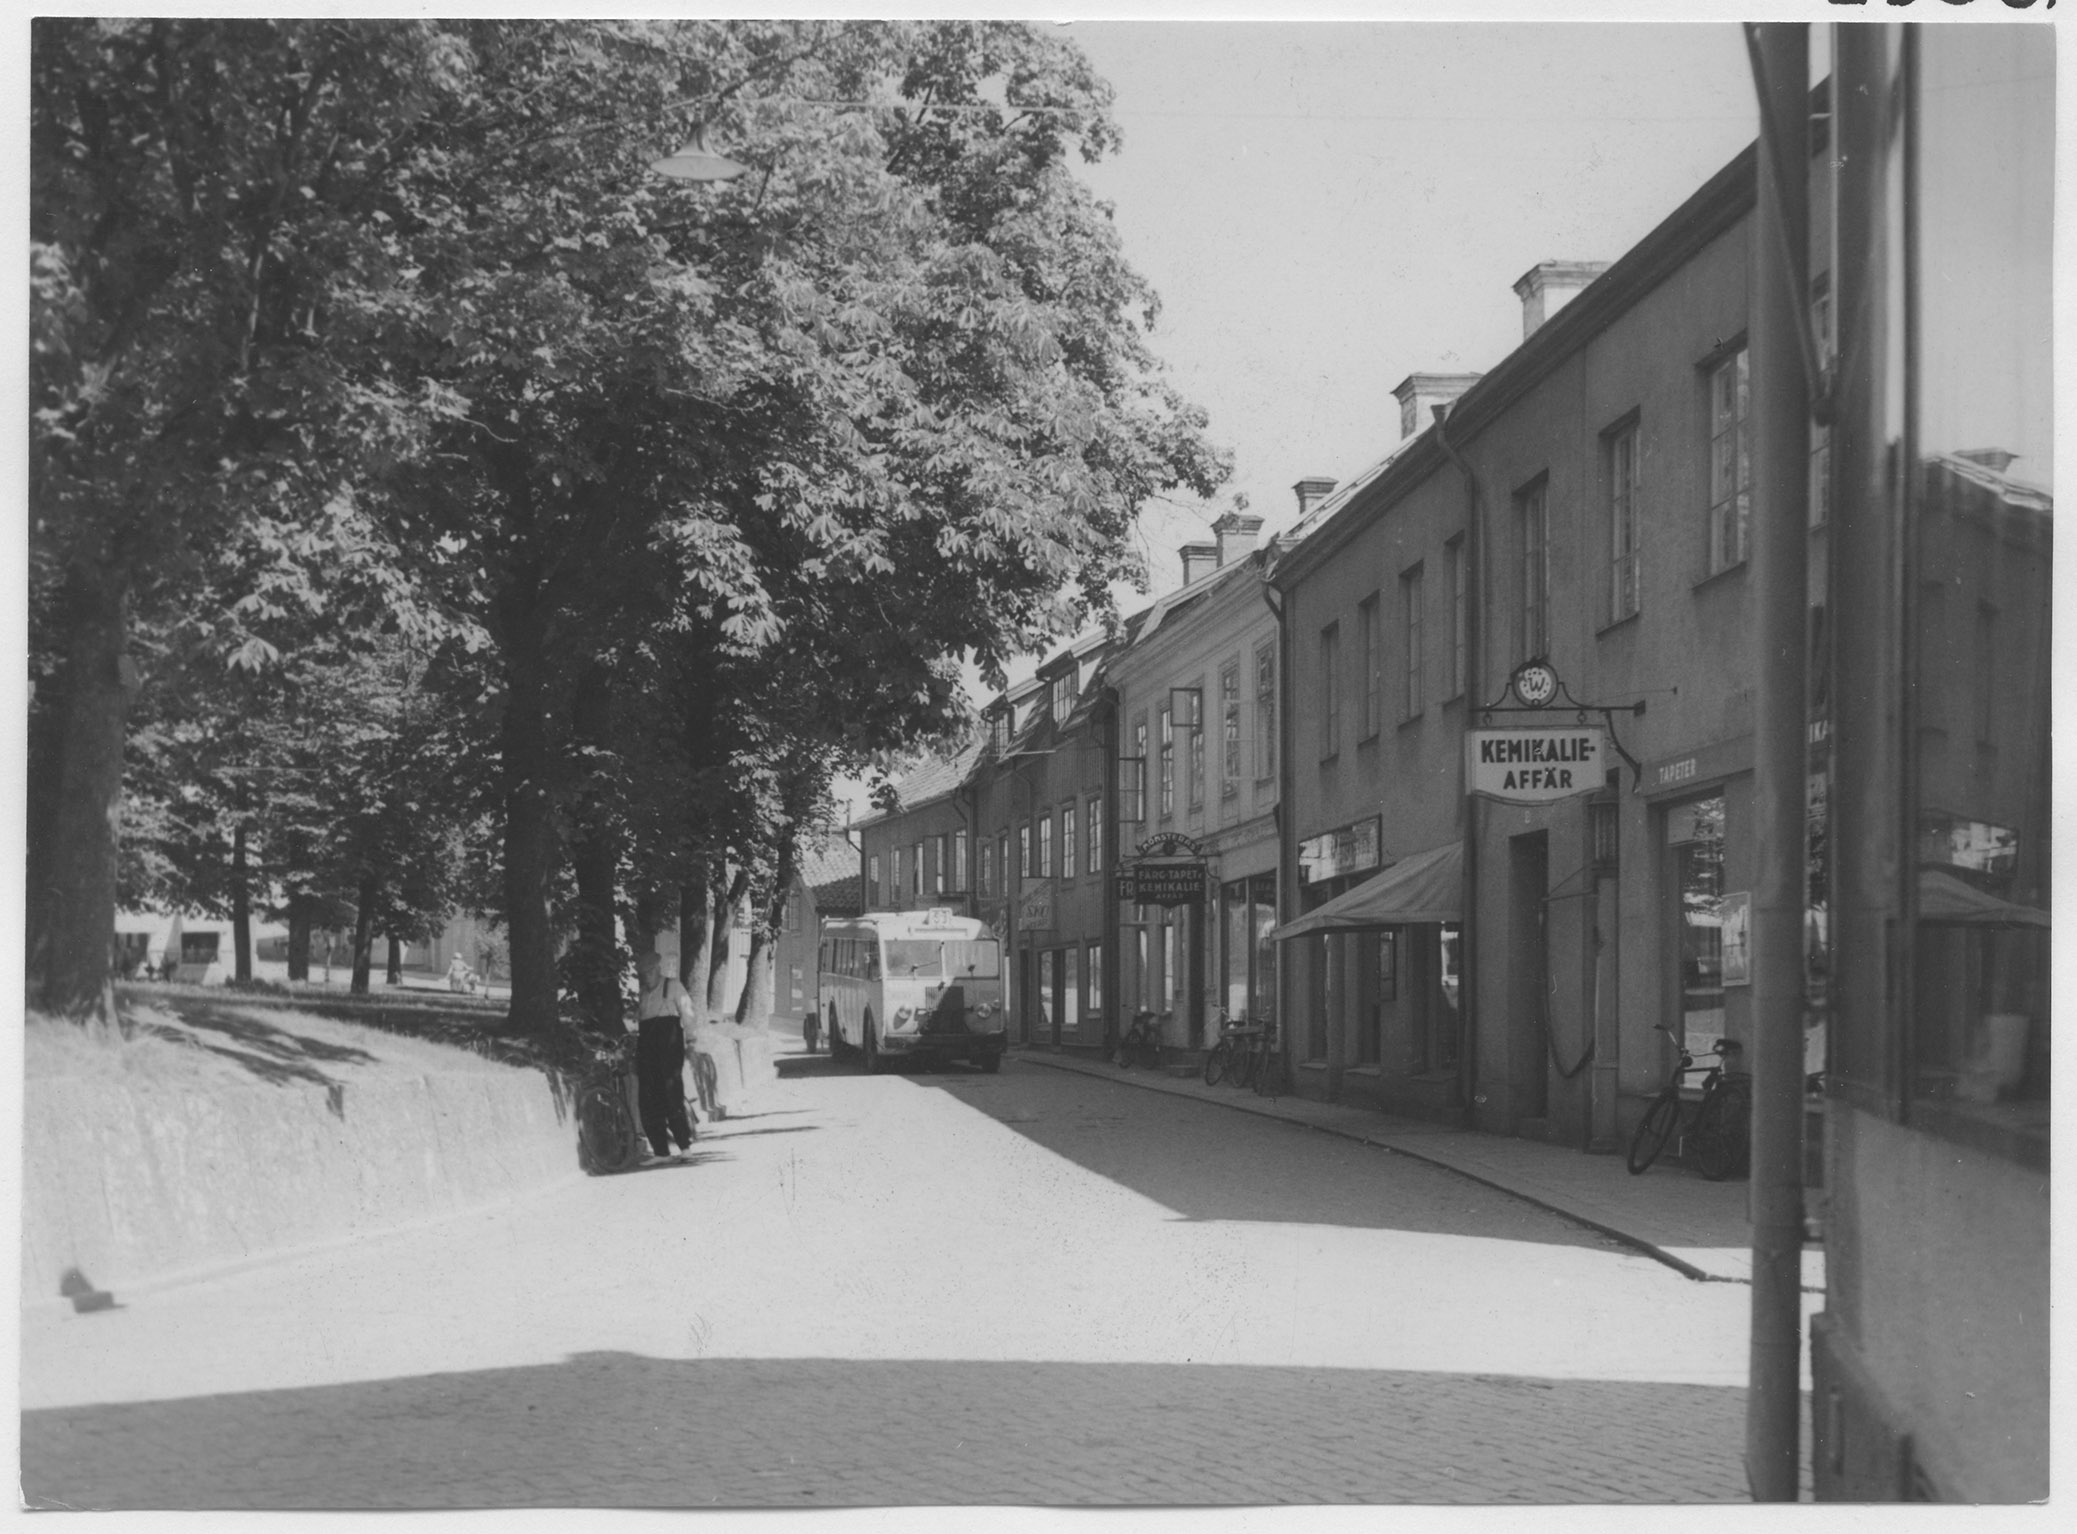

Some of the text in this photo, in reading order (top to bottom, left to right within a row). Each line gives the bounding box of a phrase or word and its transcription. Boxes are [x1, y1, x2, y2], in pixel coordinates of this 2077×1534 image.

[1528, 677, 1546, 692] W
[1481, 737, 1596, 763] KEMIKALIE-
[1503, 767, 1573, 789] AFFÄR
[1659, 758, 1696, 784] TAPETER
